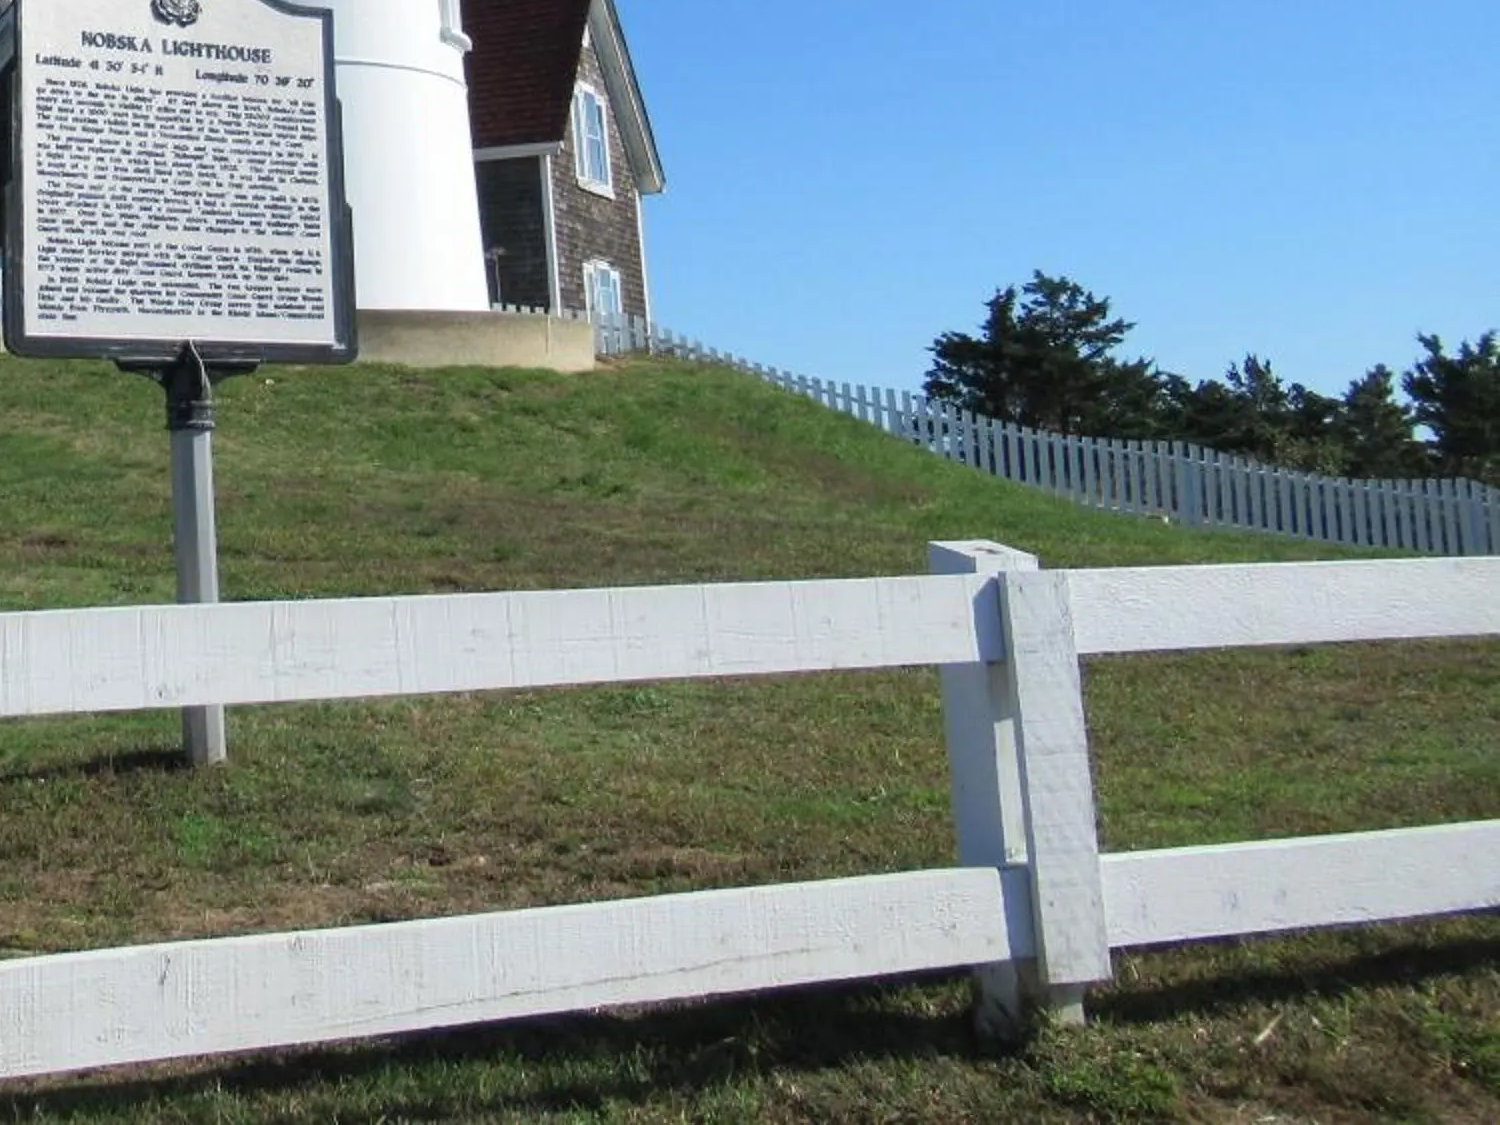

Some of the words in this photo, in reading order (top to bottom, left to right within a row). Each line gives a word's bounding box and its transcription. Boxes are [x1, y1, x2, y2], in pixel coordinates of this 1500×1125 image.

[81, 30, 152, 53] NOBSKA
[161, 39, 272, 64] LIGHTHOUSE
[36, 54, 82, 68] Latitude
[196, 69, 248, 84] Longitude
[254, 74, 268, 85] 70
